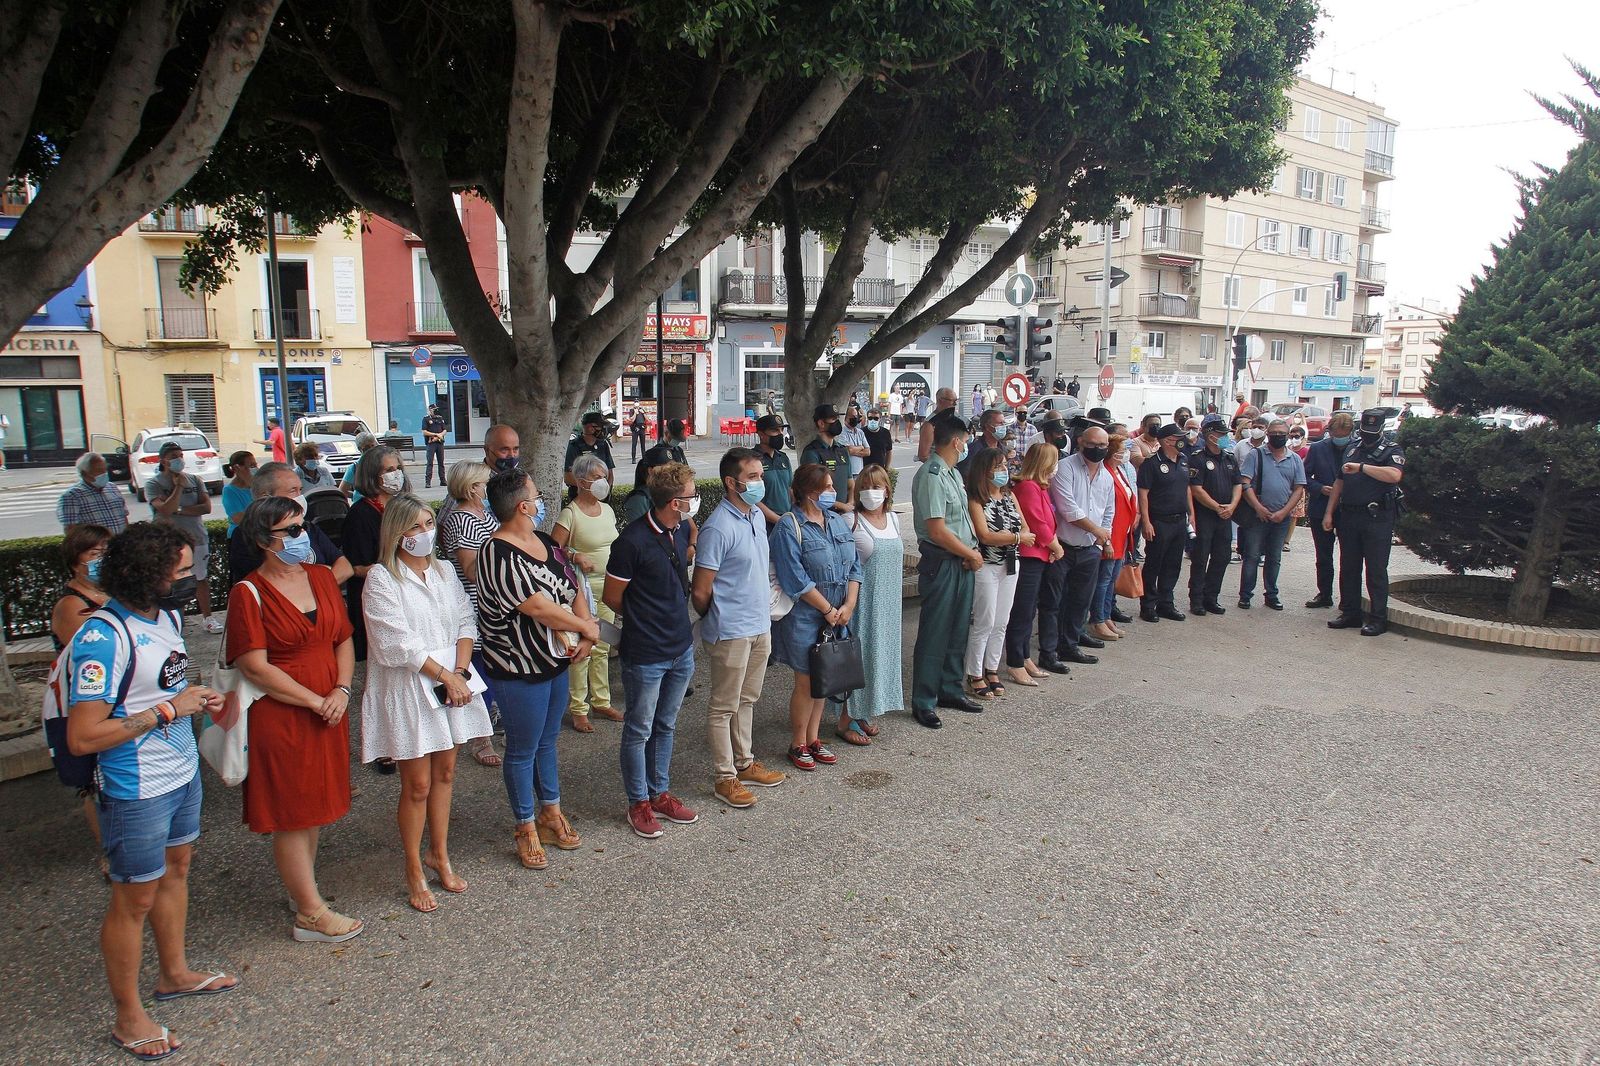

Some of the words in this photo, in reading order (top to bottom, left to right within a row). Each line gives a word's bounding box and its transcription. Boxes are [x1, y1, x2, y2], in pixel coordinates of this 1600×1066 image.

[663, 317, 691, 327] WAYS
[258, 349, 325, 357] ALONIS
[1100, 377, 1114, 387] STOP
